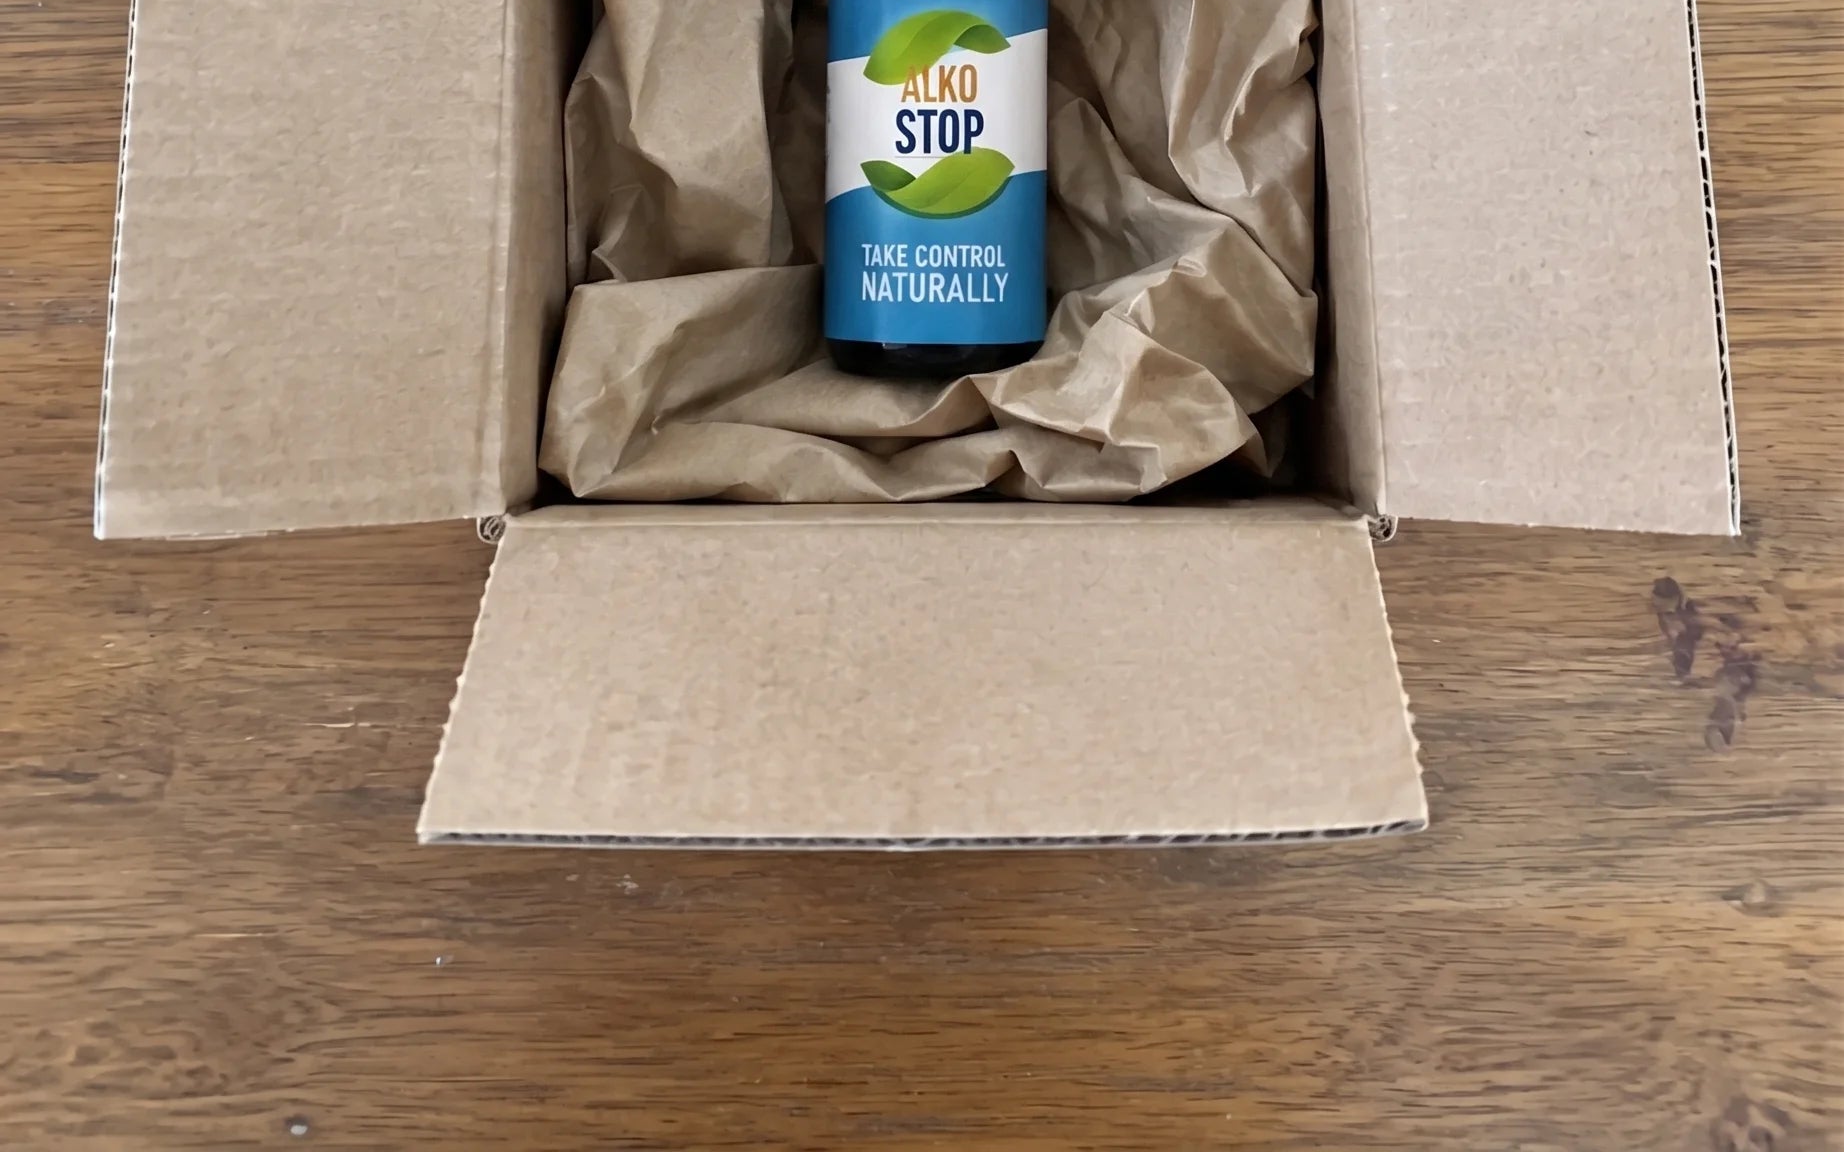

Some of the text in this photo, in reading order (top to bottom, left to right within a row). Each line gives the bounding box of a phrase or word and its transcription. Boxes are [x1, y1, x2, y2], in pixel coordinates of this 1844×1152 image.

[901, 64, 978, 103] ALKO
[895, 109, 984, 154] STOP
[861, 244, 1006, 268] TAKE CONTROL
[862, 271, 1009, 303] NATURALLY
